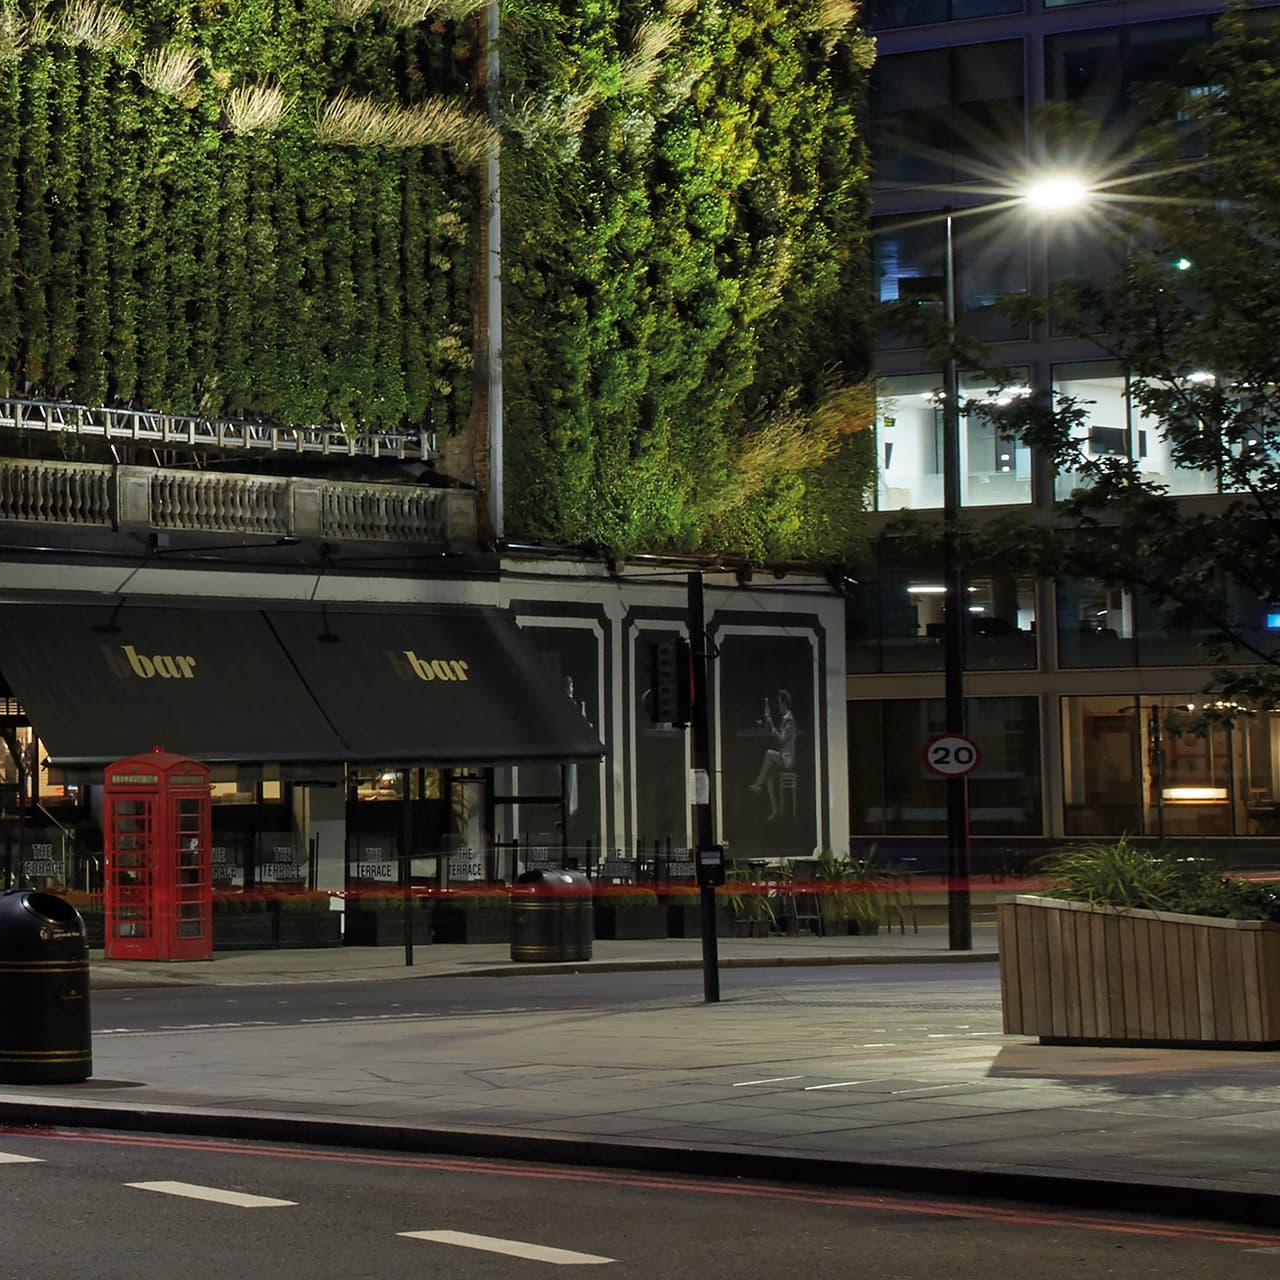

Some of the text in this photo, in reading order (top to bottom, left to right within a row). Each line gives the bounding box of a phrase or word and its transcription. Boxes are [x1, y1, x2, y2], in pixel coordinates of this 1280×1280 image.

[933, 747, 974, 765] 20
[32, 844, 53, 859] THE
[212, 848, 226, 862] HE
[273, 848, 292, 863] THE
[457, 848, 473, 861] THE
[262, 864, 302, 878] TERRACE
[448, 864, 482, 876] TERRACE
